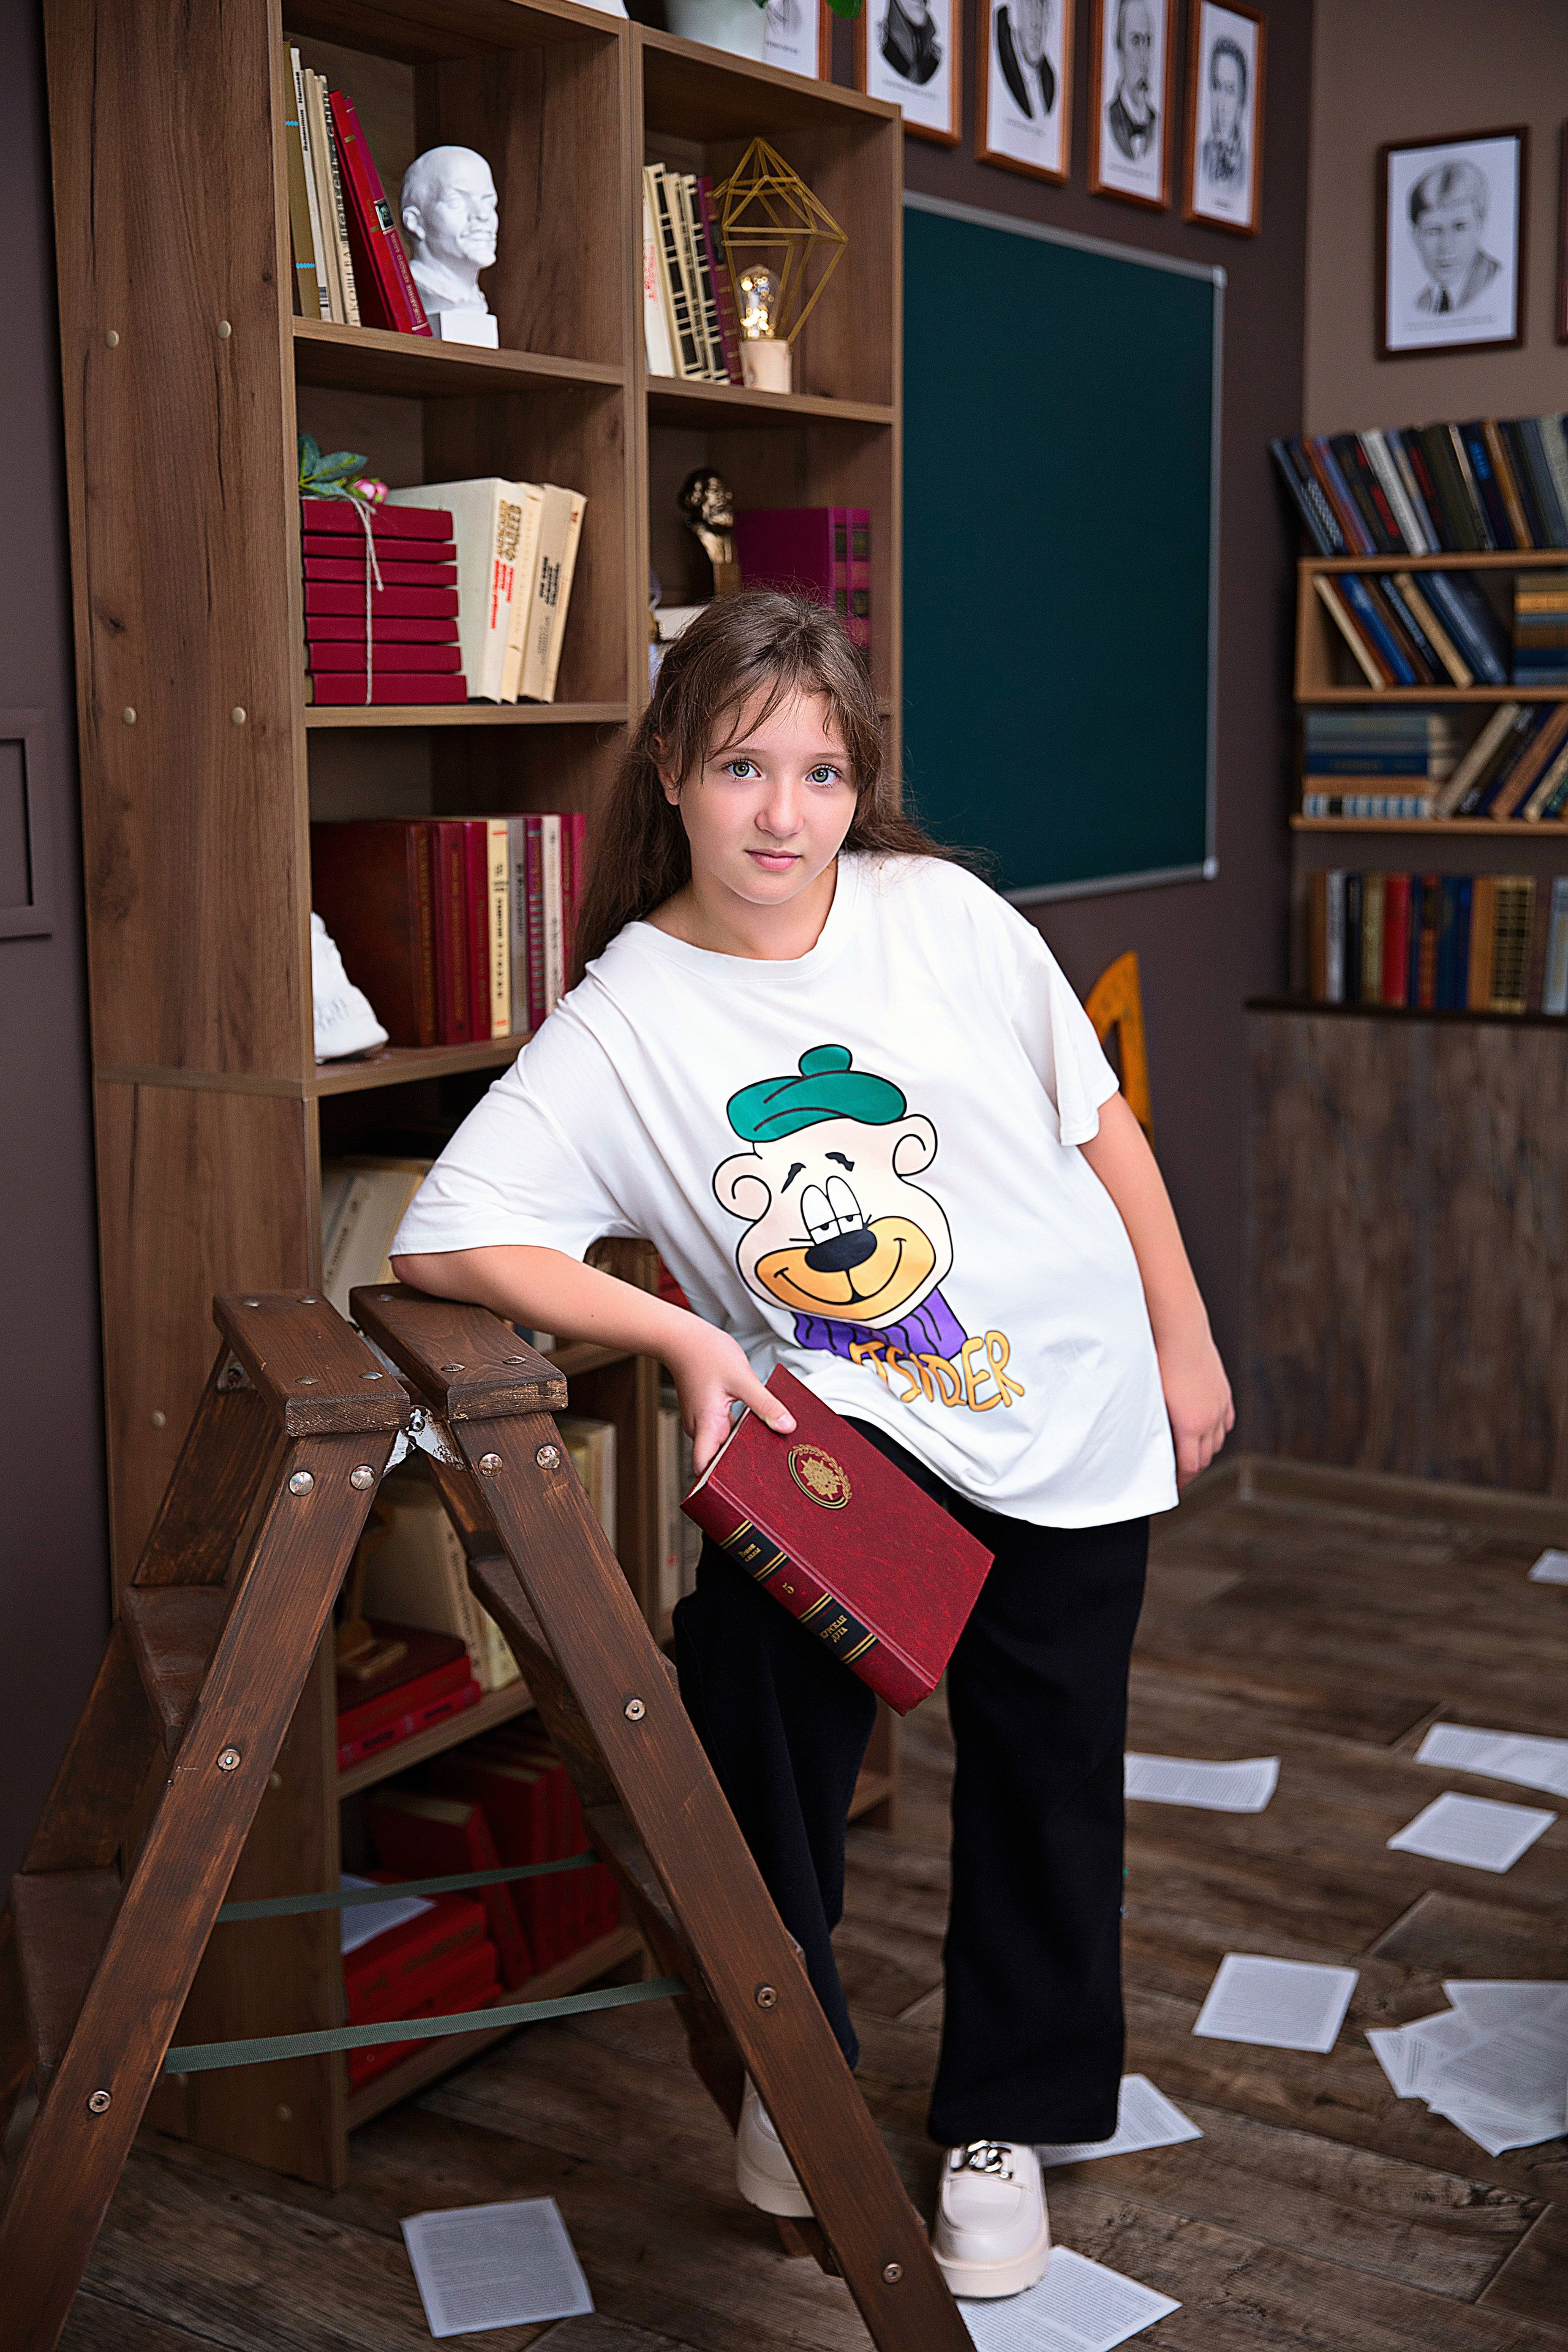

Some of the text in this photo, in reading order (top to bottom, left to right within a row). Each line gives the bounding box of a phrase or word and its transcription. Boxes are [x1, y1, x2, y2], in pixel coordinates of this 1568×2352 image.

[506, 504, 522, 561] ФАДЕЕВ
[782, 1583, 794, 1594] 5
[819, 1615, 848, 1639] КУРСКАЯ
[832, 1627, 848, 1643] ДУГА
